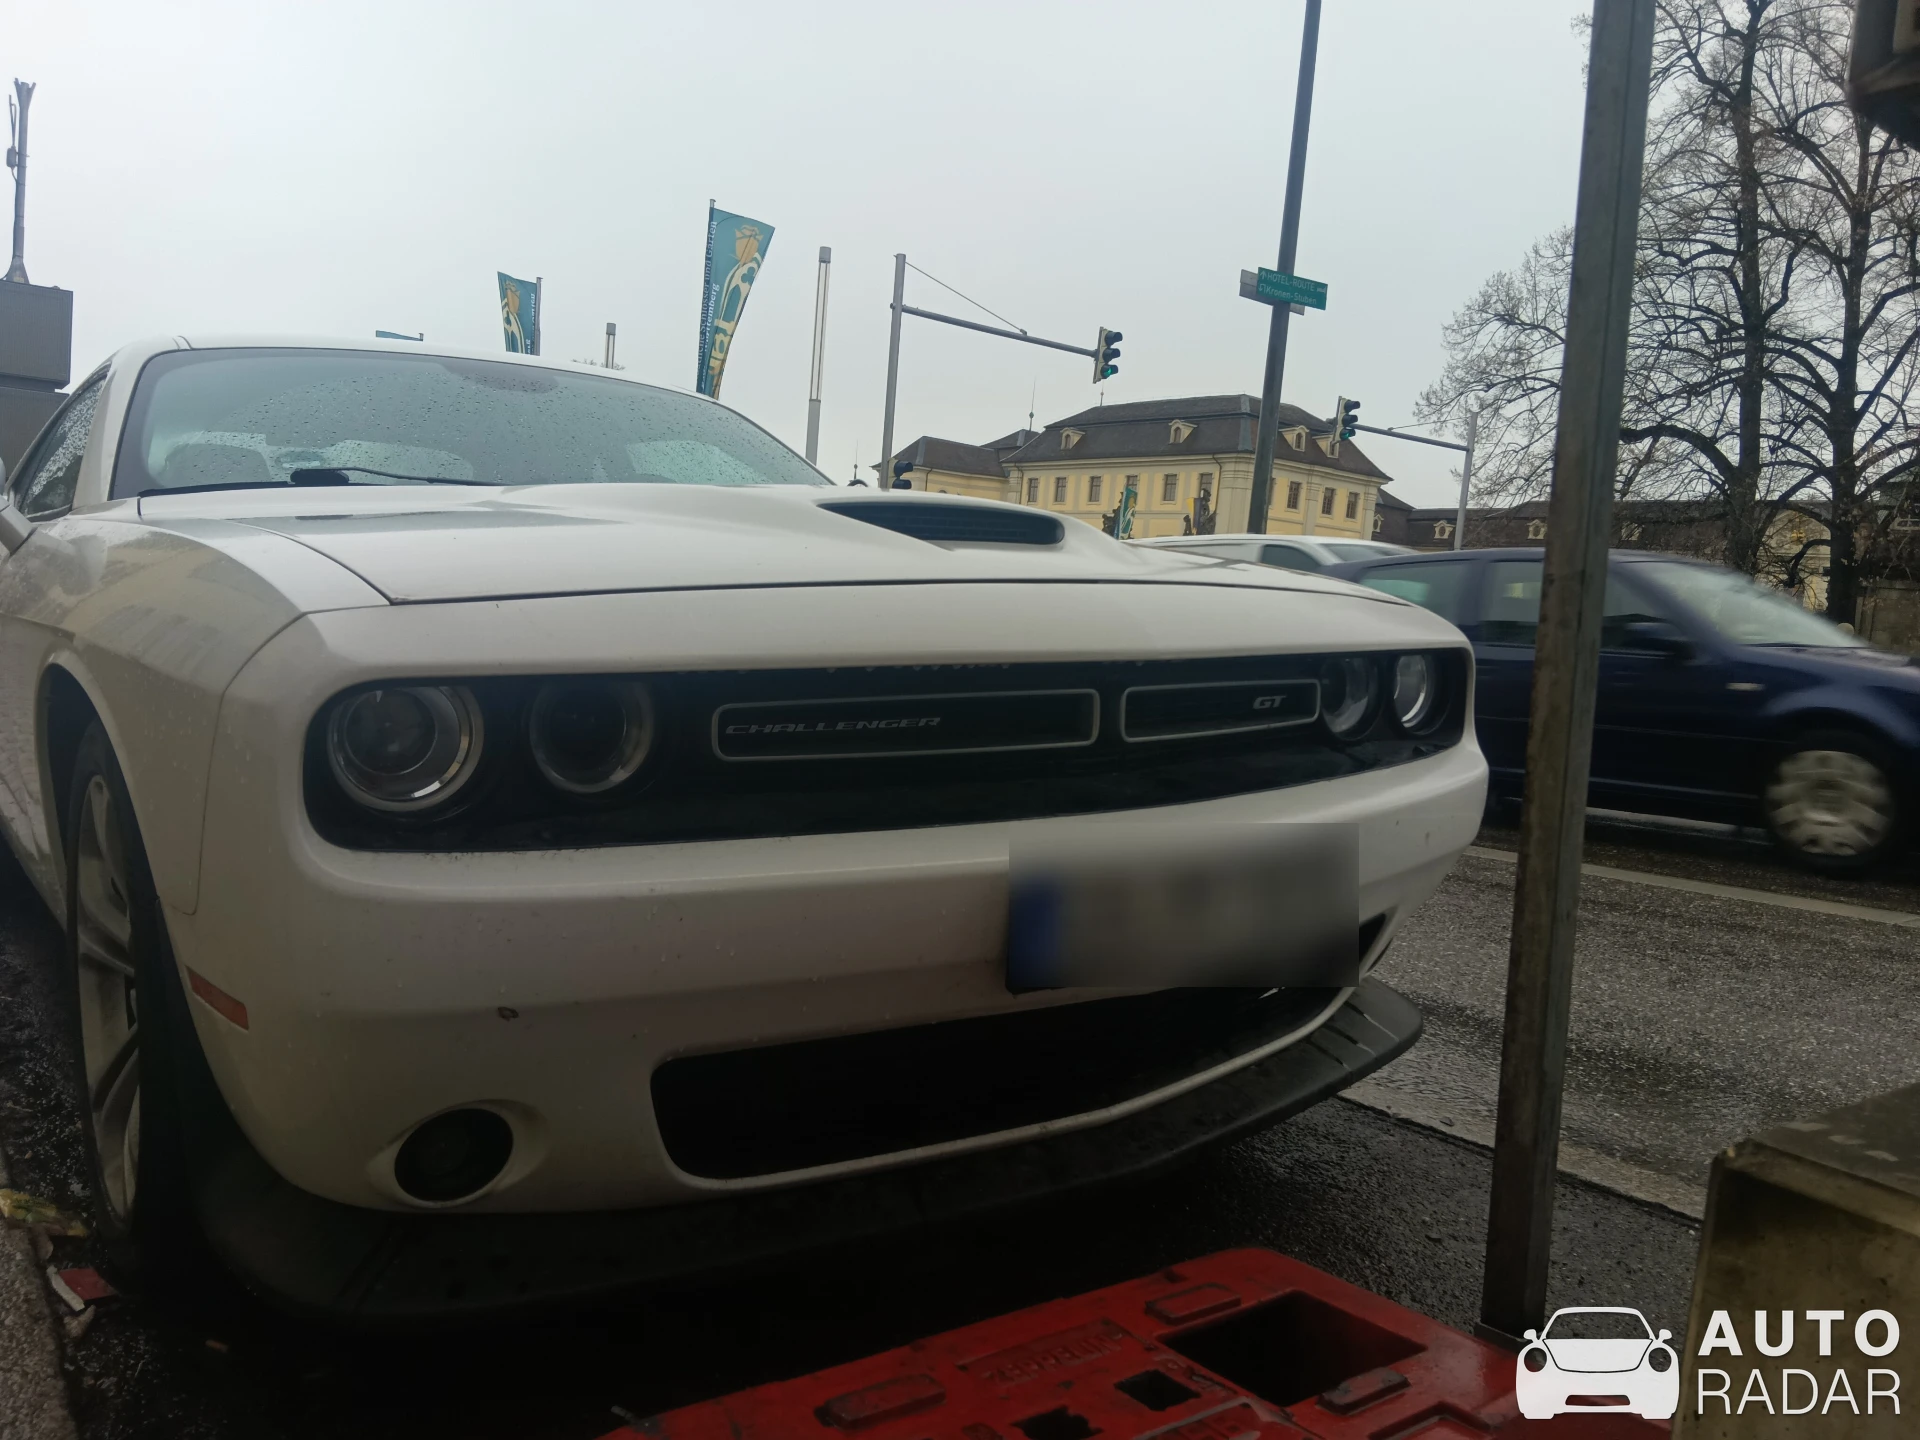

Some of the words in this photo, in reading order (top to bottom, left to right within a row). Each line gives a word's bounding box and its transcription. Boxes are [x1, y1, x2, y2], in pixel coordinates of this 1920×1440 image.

[1267, 272, 1315, 292] HOTEL-ROUTE
[1253, 695, 1287, 709] GT
[726, 717, 941, 734] CHALLENGER
